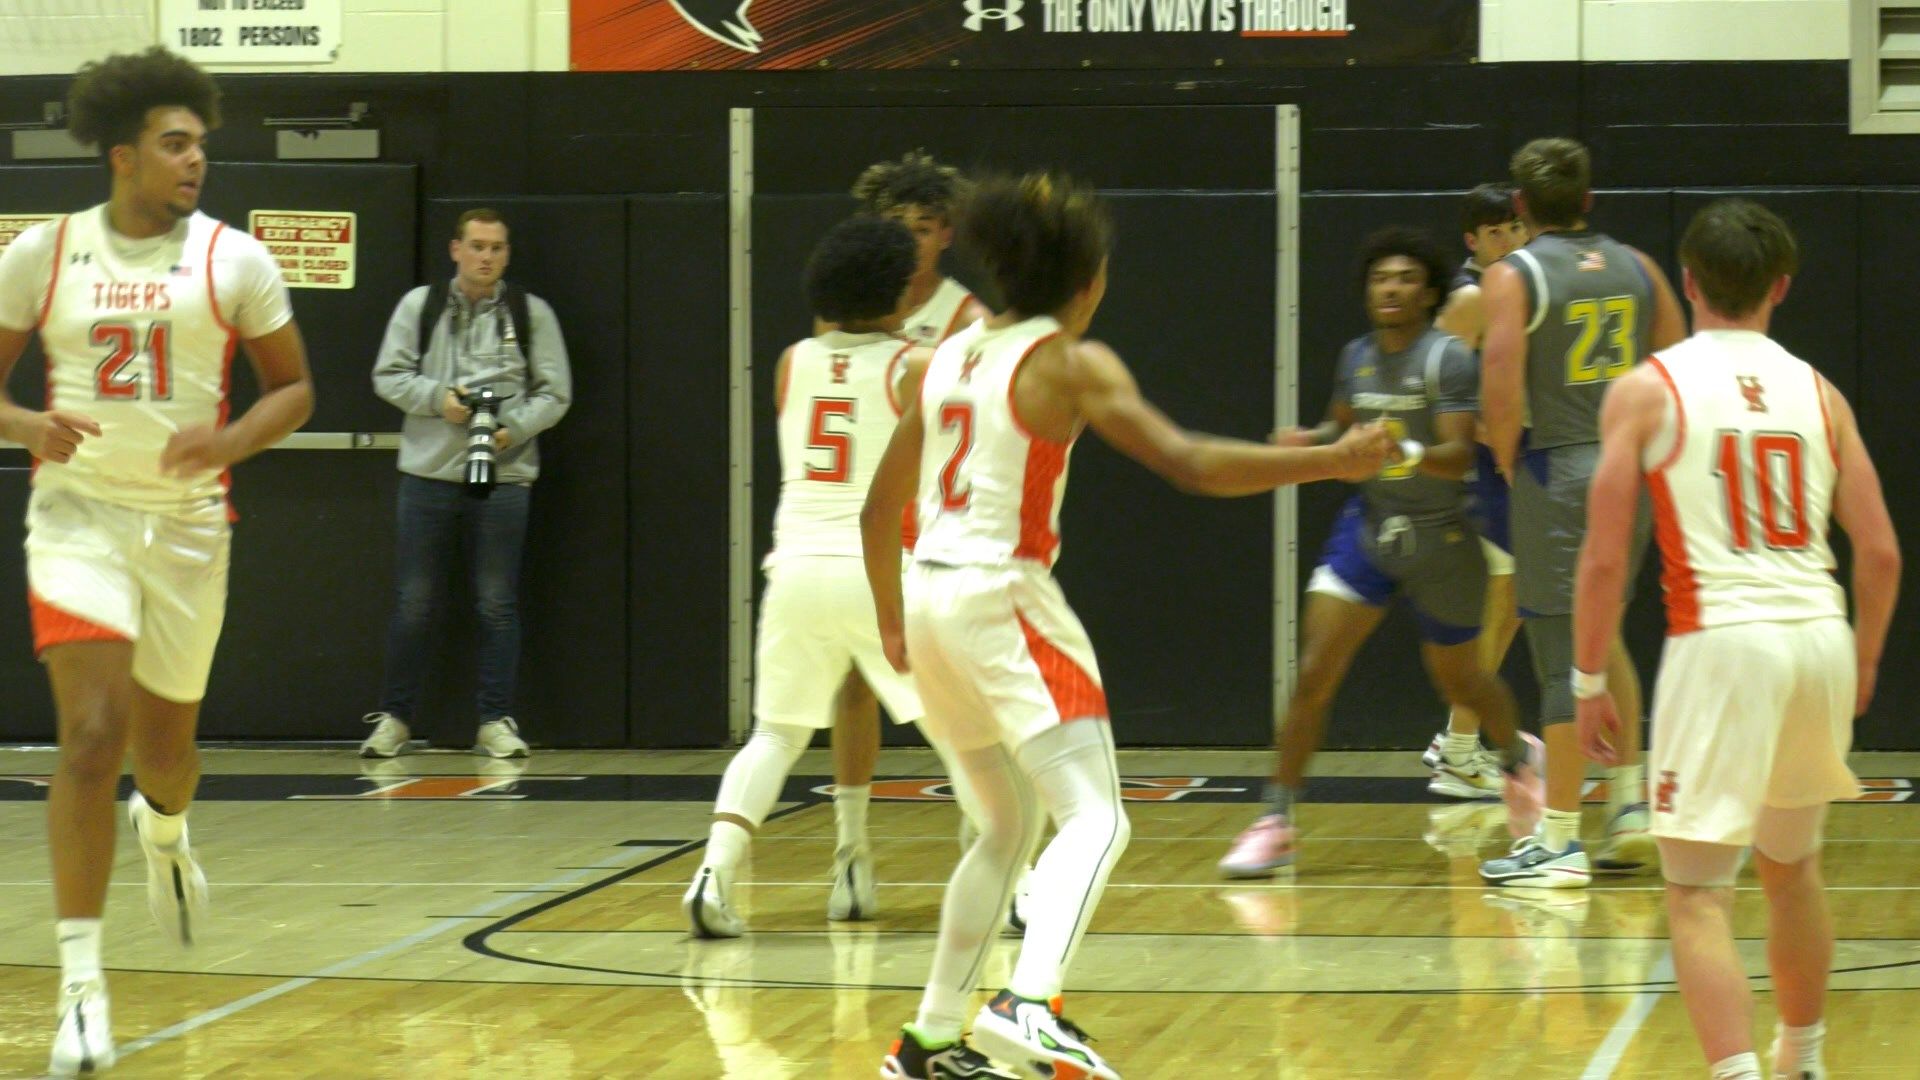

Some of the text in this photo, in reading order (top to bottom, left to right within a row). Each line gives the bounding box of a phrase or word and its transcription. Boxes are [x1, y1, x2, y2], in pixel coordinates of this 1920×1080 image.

[1043, 0, 1083, 33] THE
[1087, 0, 1144, 33] ONLY
[1149, 0, 1207, 33] WAY
[1210, 0, 1237, 33] IS
[178, 26, 321, 47] 1802 PERSONS
[256, 216, 350, 230] EMERGENCY
[262, 227, 342, 242] EXIT ONLY
[303, 260, 349, 270] CLOSED
[304, 247, 337, 257] MUST
[305, 272, 341, 284] TIMES
[93, 281, 171, 310] TIGERS
[1564, 294, 1636, 386] 23
[89, 320, 173, 401] 21
[803, 396, 858, 486] 5
[938, 398, 978, 516] 2
[1711, 428, 1810, 555] 10
